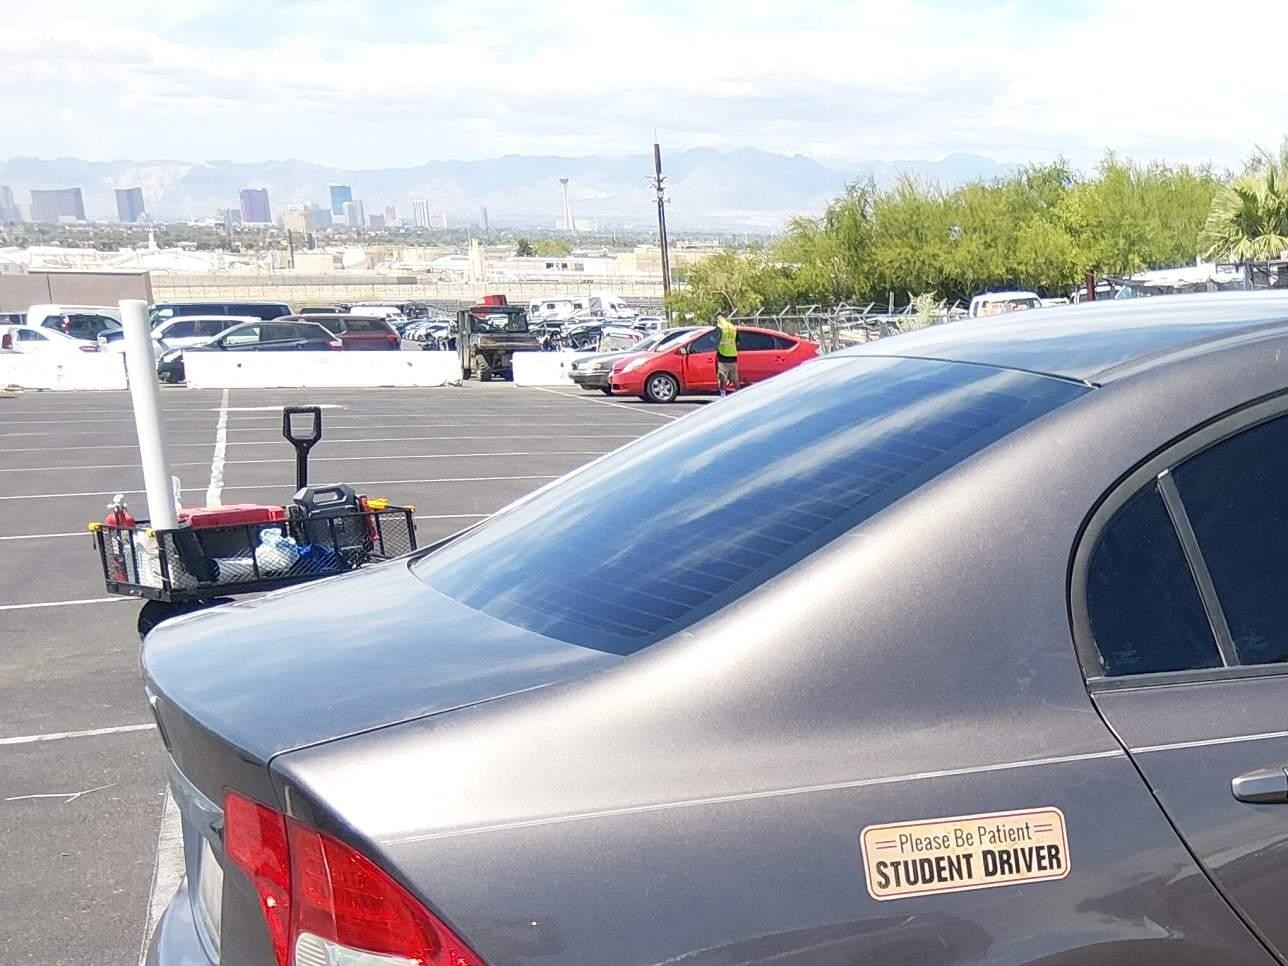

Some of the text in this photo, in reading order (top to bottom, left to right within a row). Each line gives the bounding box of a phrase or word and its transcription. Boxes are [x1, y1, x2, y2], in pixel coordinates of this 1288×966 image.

[898, 821, 1033, 854] Please Be Patient
[875, 843, 1062, 890] STUDENT DRIVER
